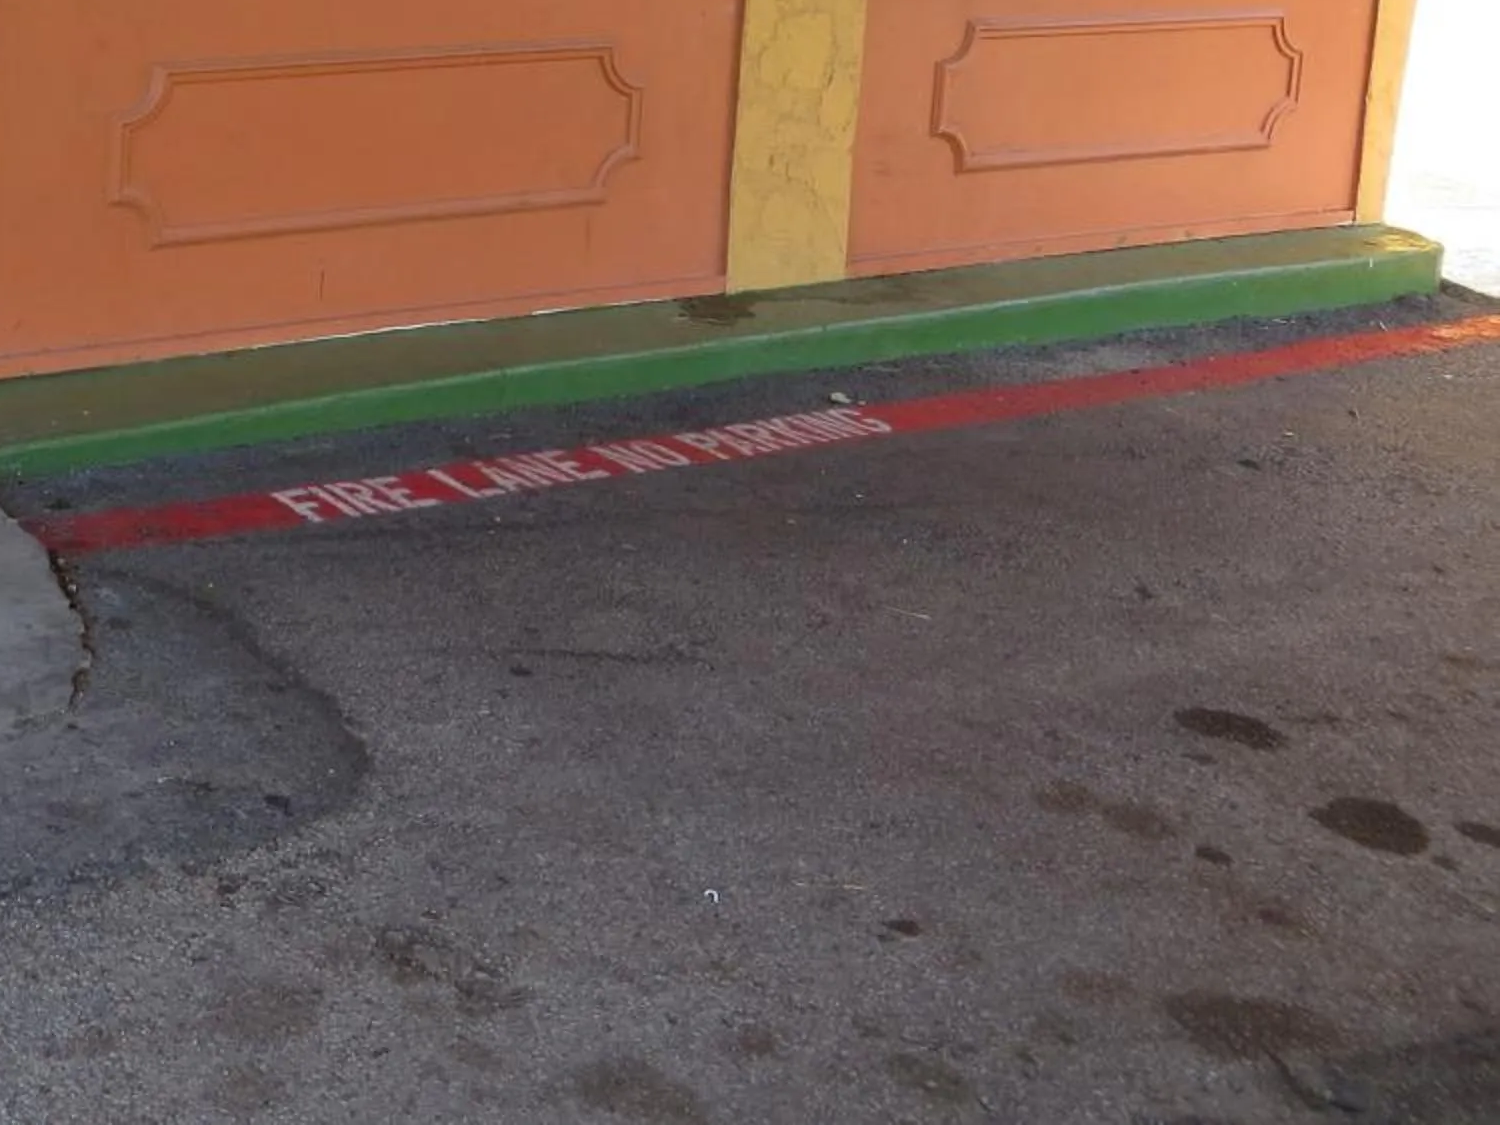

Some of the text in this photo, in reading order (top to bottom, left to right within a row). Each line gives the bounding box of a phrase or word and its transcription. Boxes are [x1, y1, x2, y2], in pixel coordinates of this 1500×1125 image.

[270, 408, 893, 523] FIRE LANE NO PARKING
